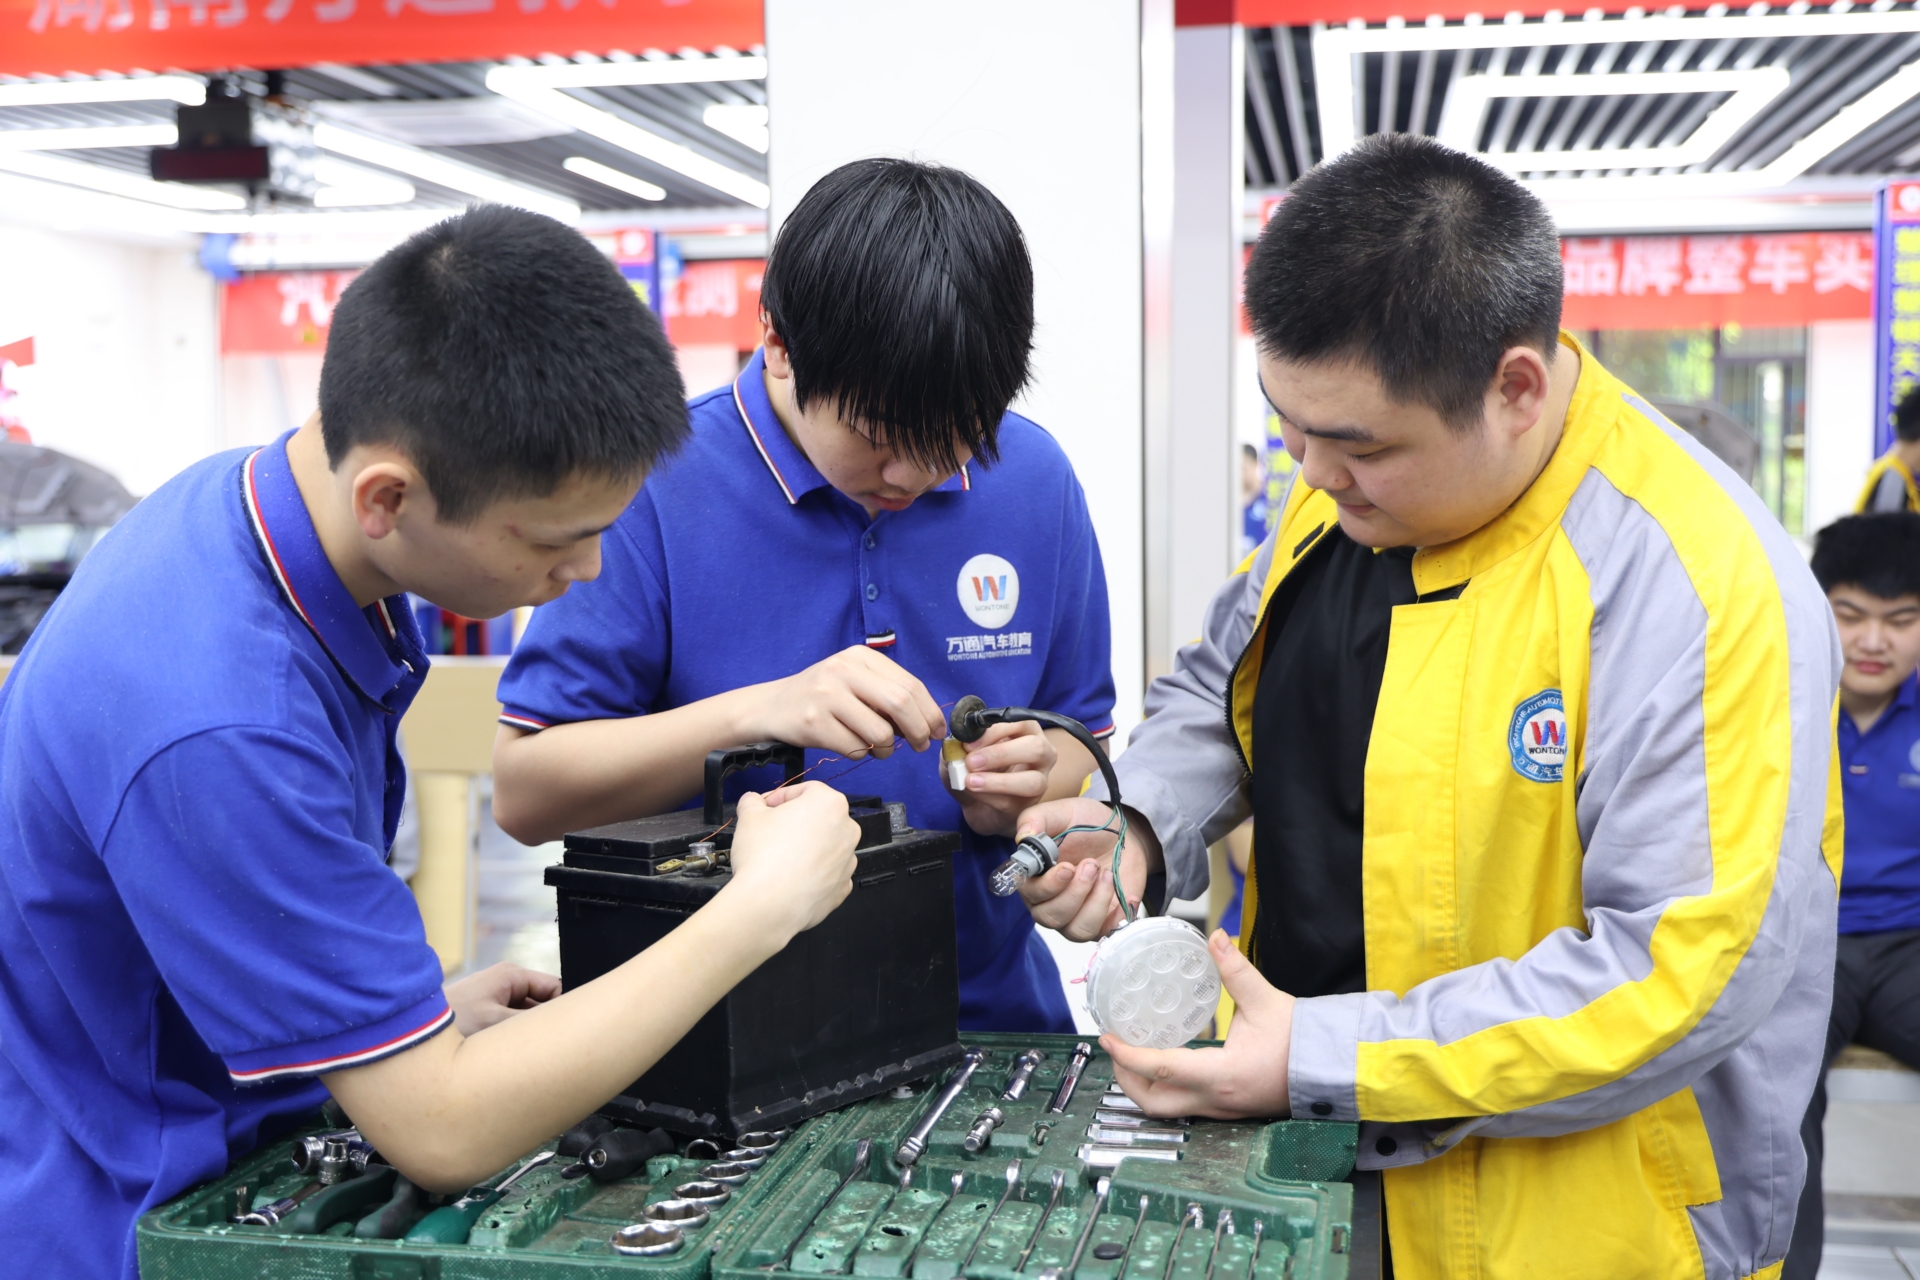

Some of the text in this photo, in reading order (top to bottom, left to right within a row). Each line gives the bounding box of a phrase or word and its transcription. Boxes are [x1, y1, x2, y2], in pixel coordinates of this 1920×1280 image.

[975, 604, 1010, 612] WONTONE
[946, 632, 1032, 653] 万通汽车教育
